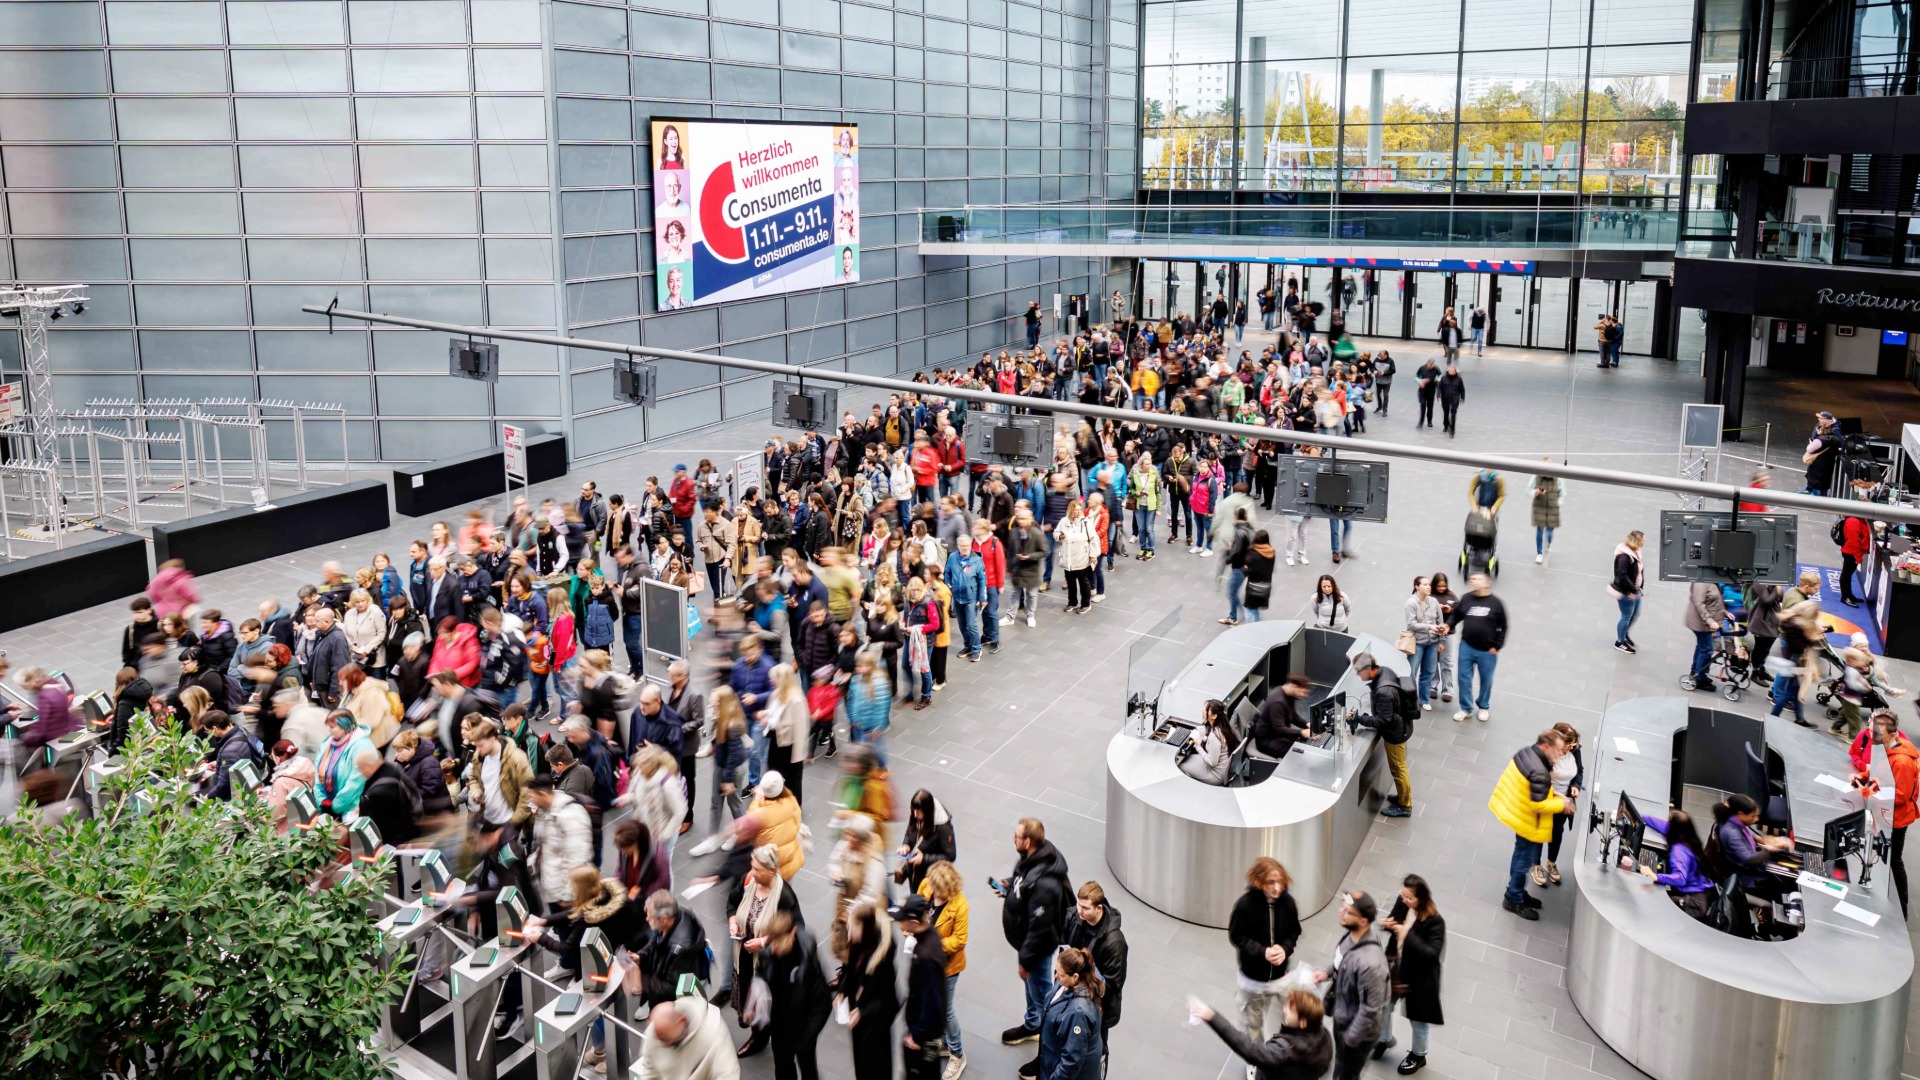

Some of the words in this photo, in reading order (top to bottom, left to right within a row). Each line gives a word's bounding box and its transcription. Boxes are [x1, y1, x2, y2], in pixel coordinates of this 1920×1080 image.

[738, 140, 793, 168] Herzlich
[741, 155, 819, 189] willkommen
[728, 177, 823, 221] Consumenta
[754, 230, 829, 268] consumenta.de
